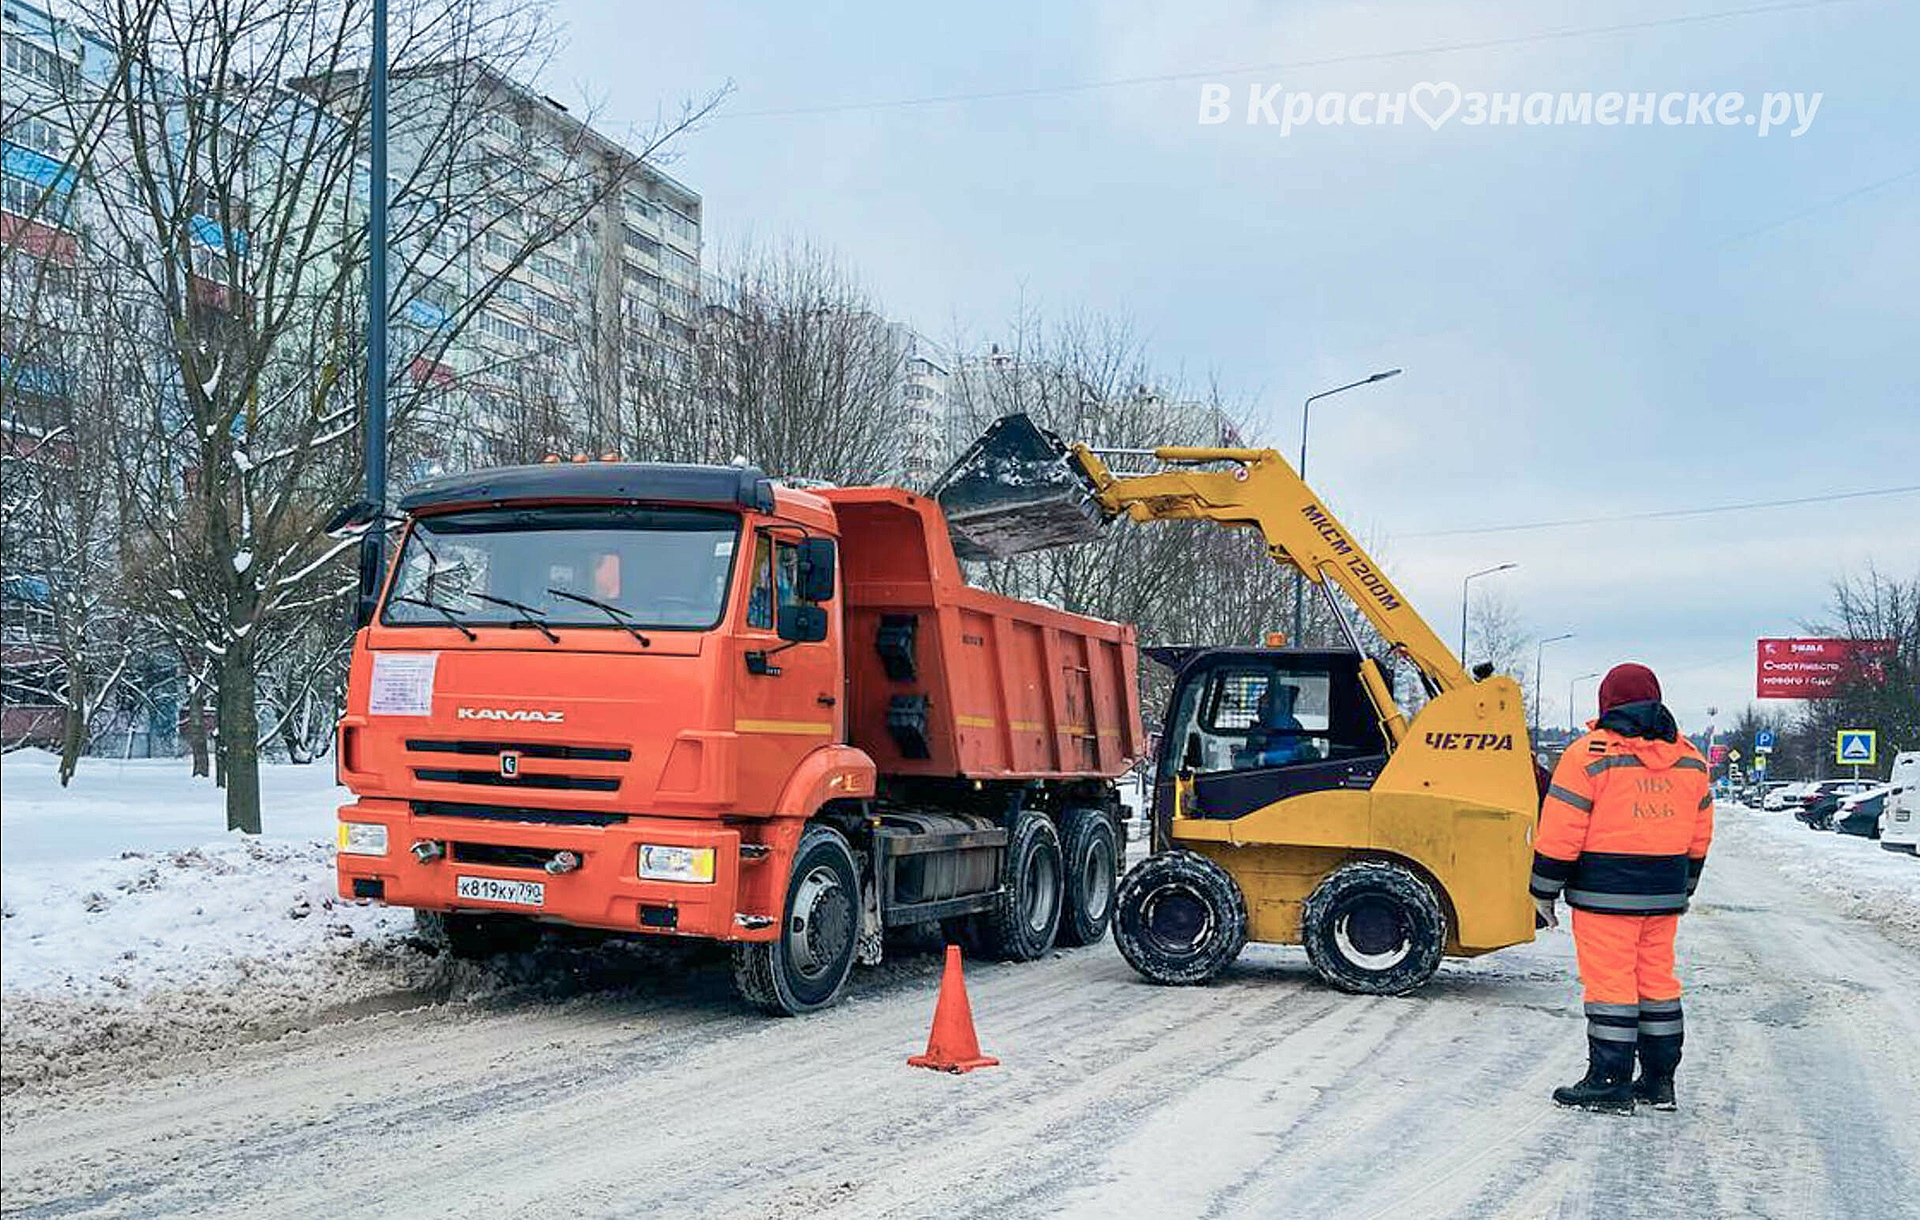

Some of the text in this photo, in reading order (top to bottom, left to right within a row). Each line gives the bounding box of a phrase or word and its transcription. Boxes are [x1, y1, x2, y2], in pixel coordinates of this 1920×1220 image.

[1301, 504, 1400, 611] МКСМ 1200М
[458, 708, 564, 722] KAMAZ
[1425, 732, 1513, 751] ЧЕТРА
[1760, 732, 1771, 746] P
